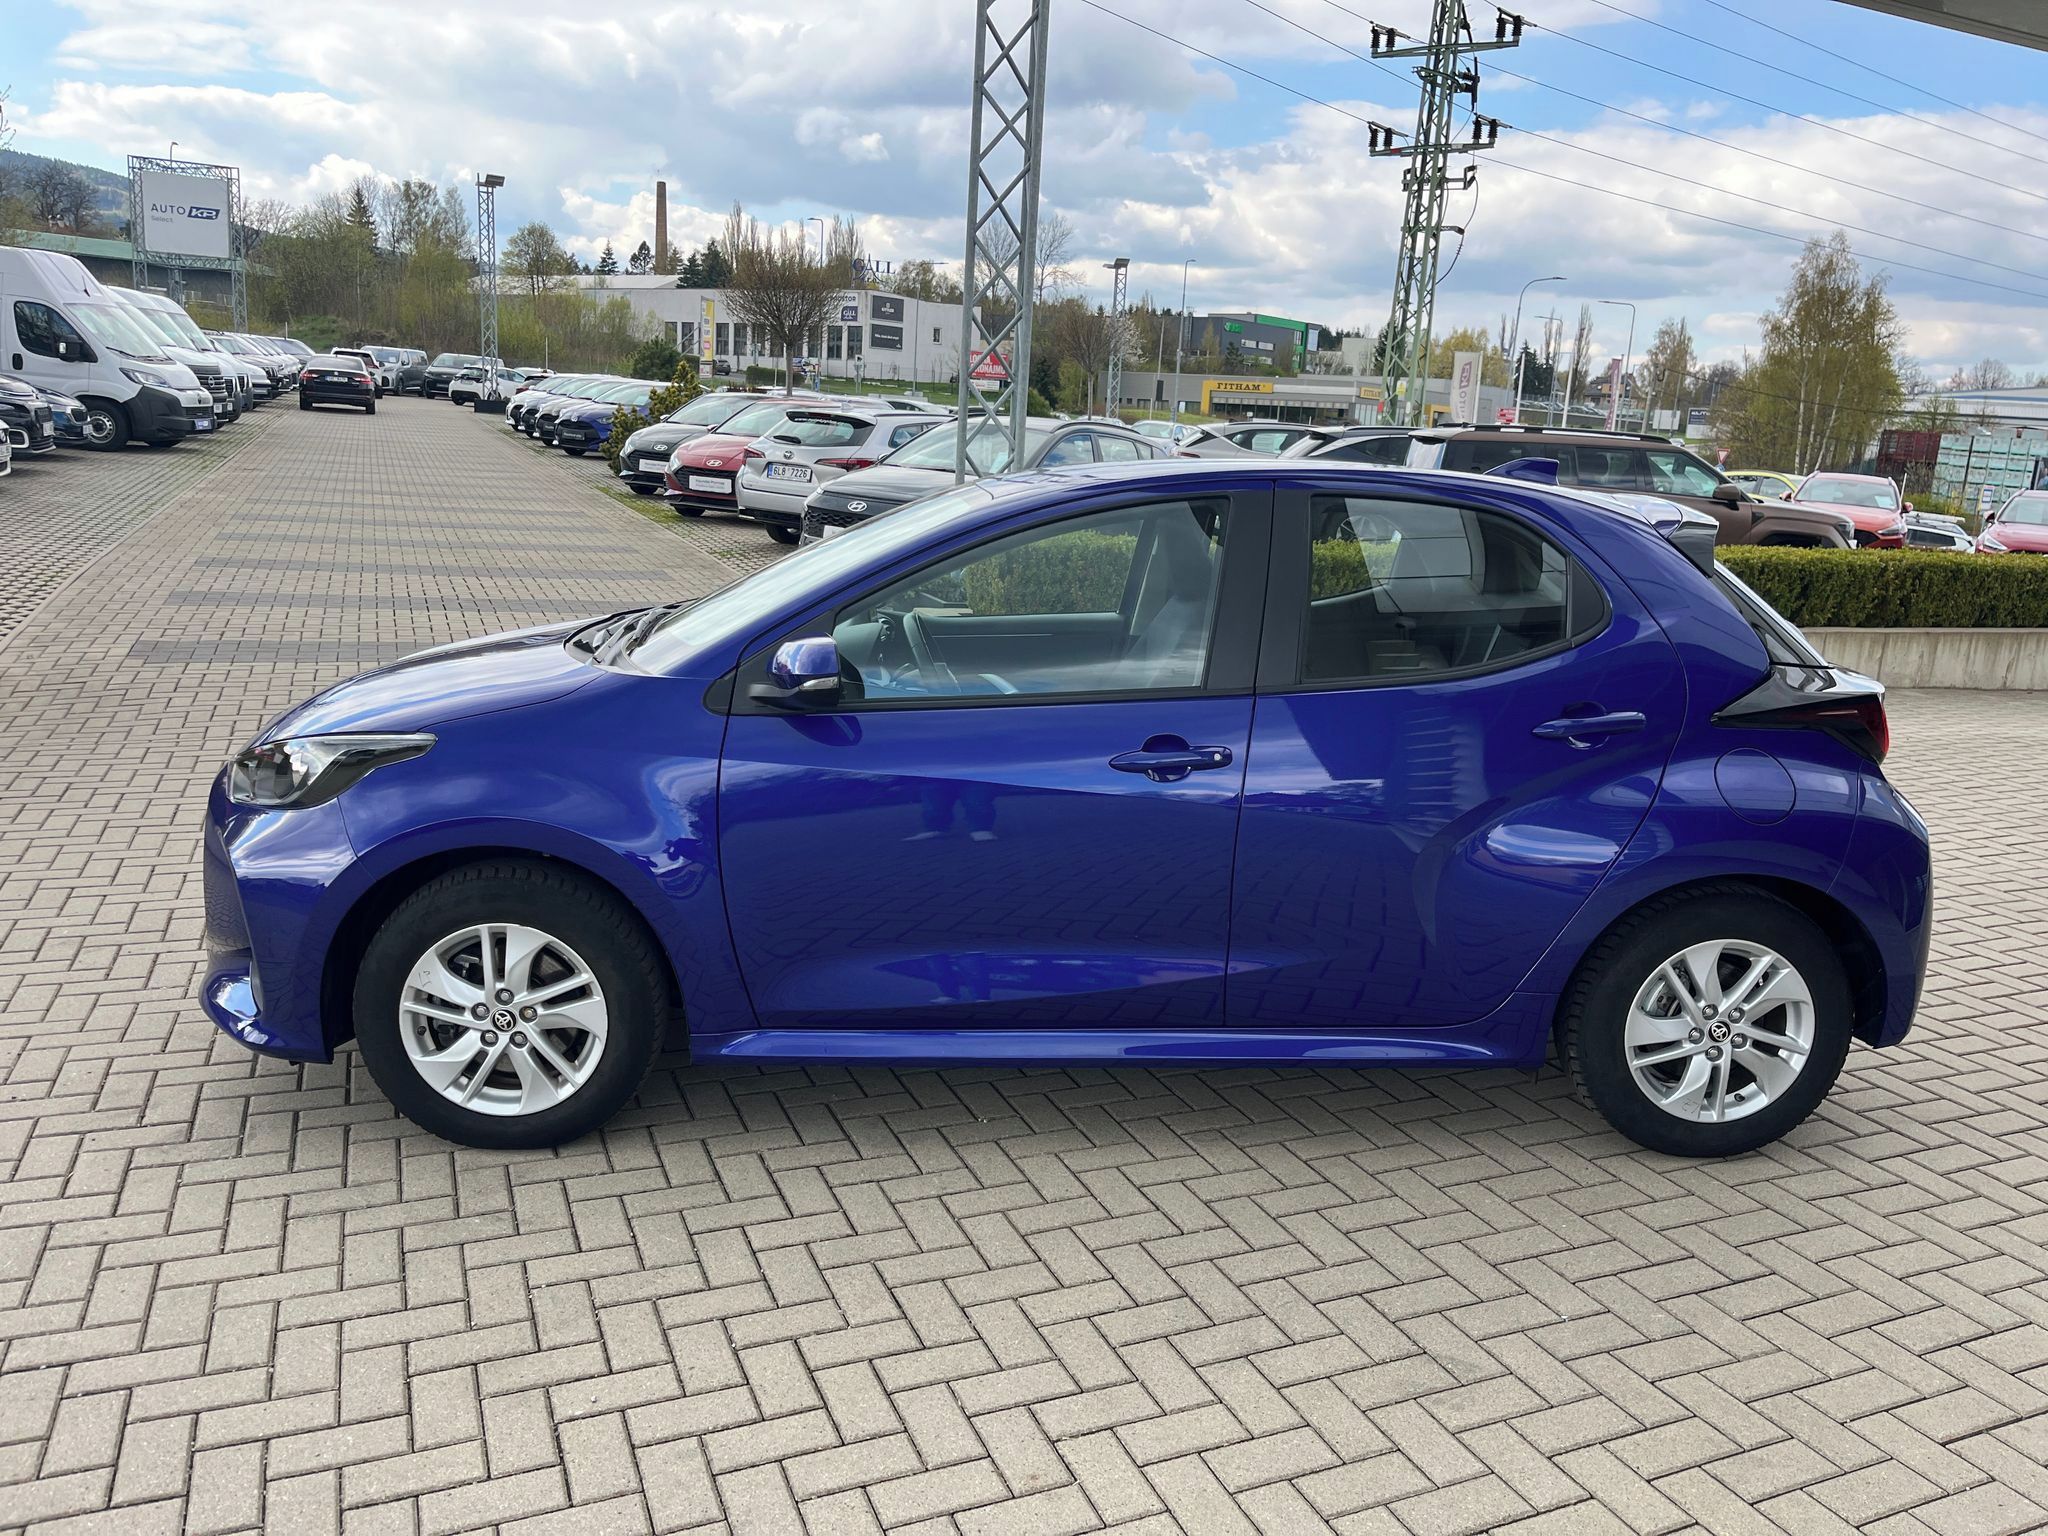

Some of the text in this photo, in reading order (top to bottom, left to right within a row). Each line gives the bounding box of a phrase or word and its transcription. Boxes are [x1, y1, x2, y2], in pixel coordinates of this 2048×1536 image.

[151, 203, 186, 216] AUTO
[773, 466, 808, 478] 6L8 7226
